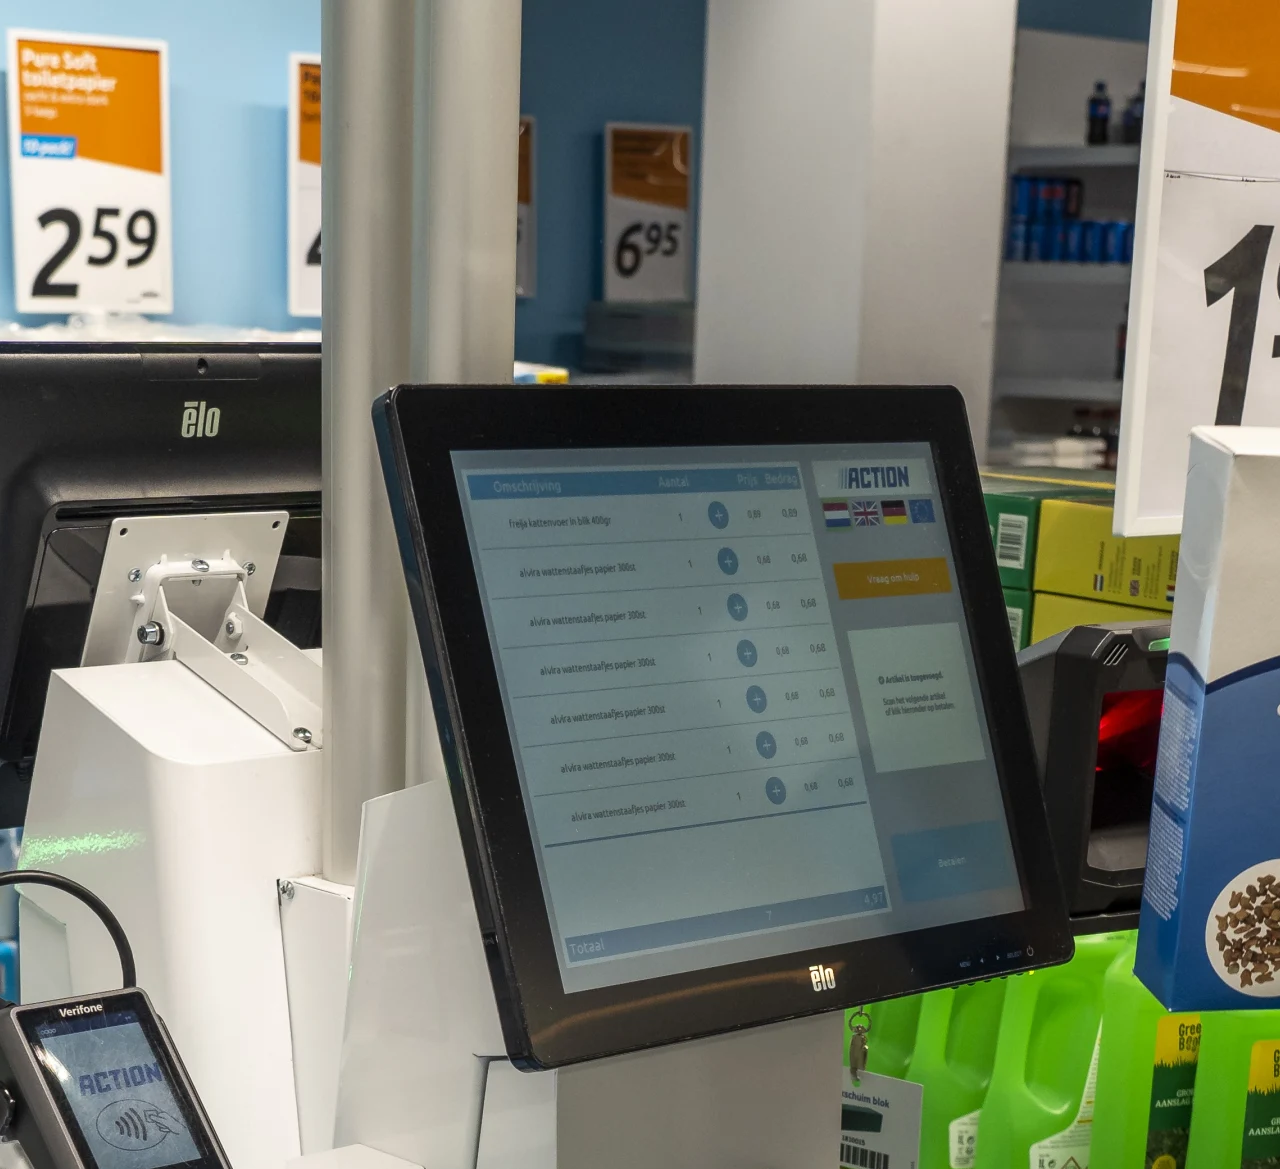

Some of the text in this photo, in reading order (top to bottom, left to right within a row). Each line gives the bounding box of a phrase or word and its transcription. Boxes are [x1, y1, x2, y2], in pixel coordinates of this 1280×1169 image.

[22, 48, 98, 71] Pure Soft
[22, 70, 117, 92] toiletpapier
[493, 473, 798, 495] Omschrijving Aantal Prijs Bedrag
[848, 466, 910, 489] ACTION
[509, 518, 528, 530] freija
[528, 516, 569, 528] kattenvoer
[569, 517, 577, 526] in
[577, 516, 590, 526] blik
[591, 515, 611, 527] 400gr
[747, 509, 762, 519] 0,89
[781, 508, 798, 518] 0,89
[519, 566, 541, 578] alvira
[542, 563, 594, 577] wattenstaafjes
[594, 563, 616, 575] papier
[617, 562, 636, 573] 300st
[756, 555, 771, 565] 0,68
[791, 553, 808, 564] 0,68
[867, 572, 919, 584] Vraag om hulp
[938, 854, 967, 868] Betalen
[569, 892, 884, 956] Totaal 7 4,97
[58, 1003, 103, 1018] Verifone
[79, 1062, 163, 1096] ACTION
[872, 1096, 889, 1109] blok
